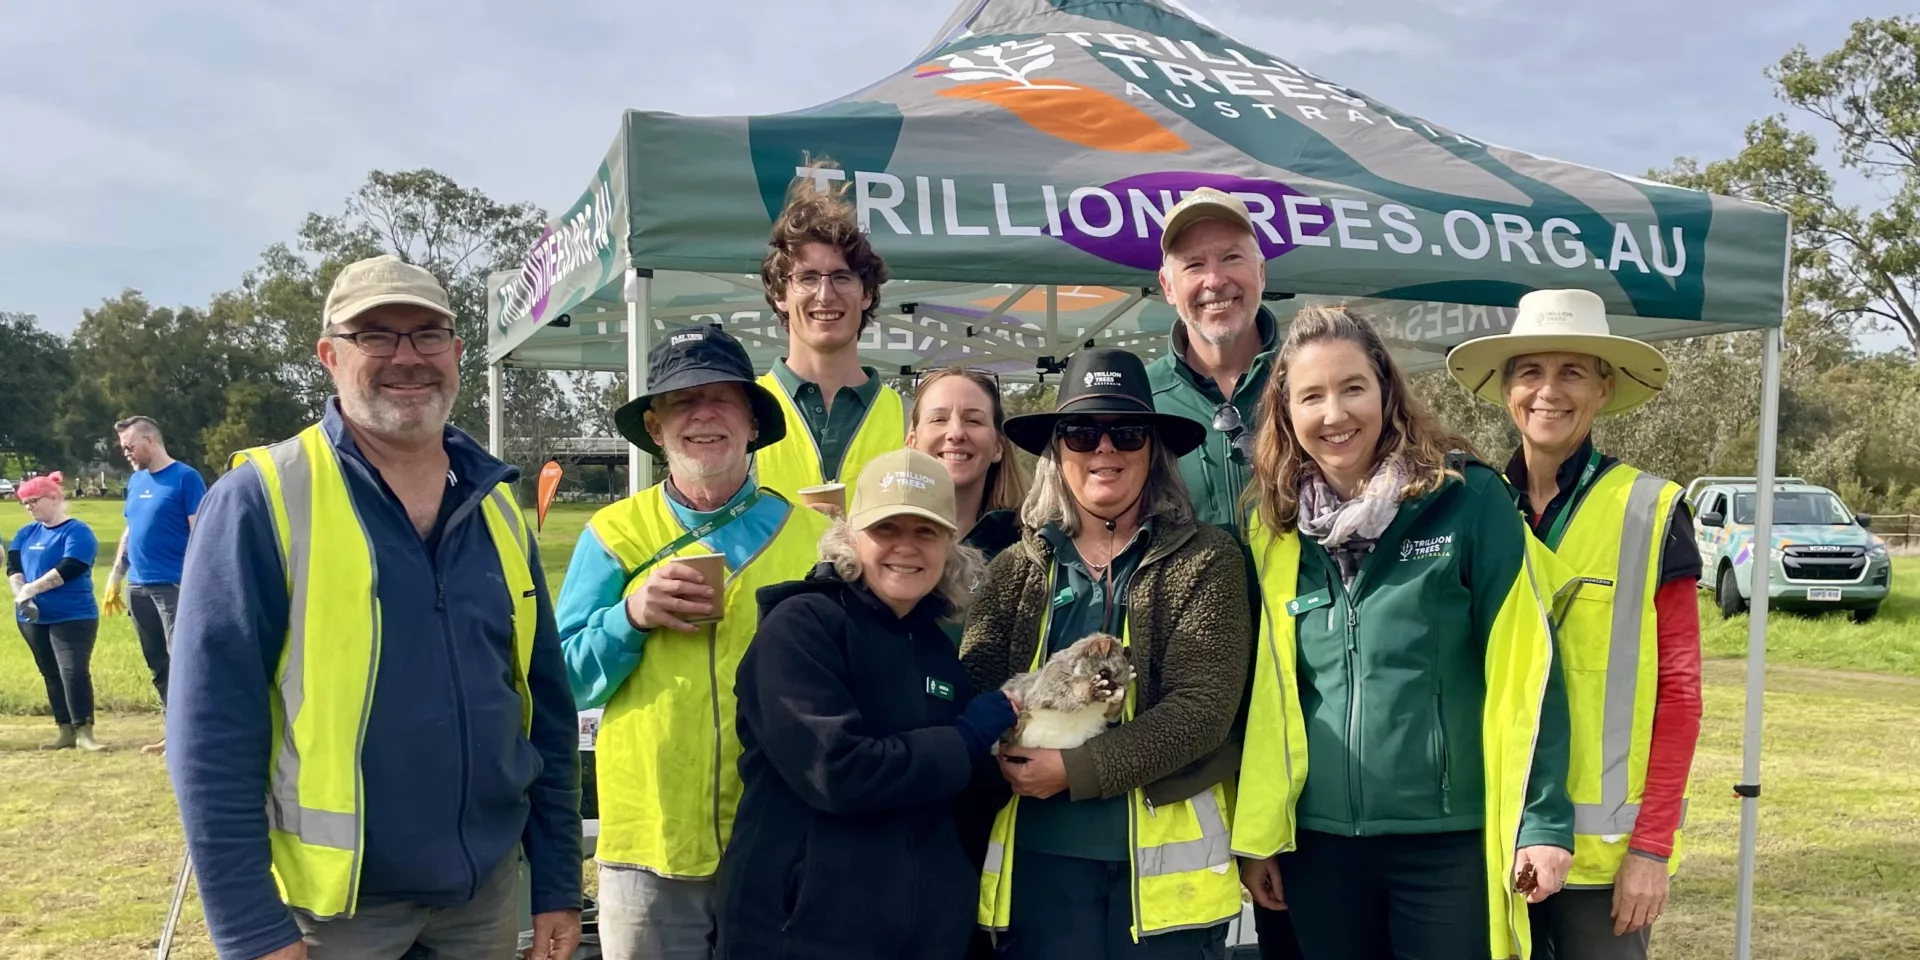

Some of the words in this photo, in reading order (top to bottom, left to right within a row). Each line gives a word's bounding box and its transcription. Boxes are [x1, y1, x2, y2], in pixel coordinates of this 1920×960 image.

[1098, 51, 1368, 108] TREES
[1125, 81, 1483, 148] AUSTRALIA
[795, 165, 1687, 277] TRILLIONREES.ORG.AU
[894, 471, 936, 486] TRILLION
[896, 478, 926, 489] TREES
[1413, 535, 1452, 548] TRILLION
[1414, 544, 1441, 555] TREES
